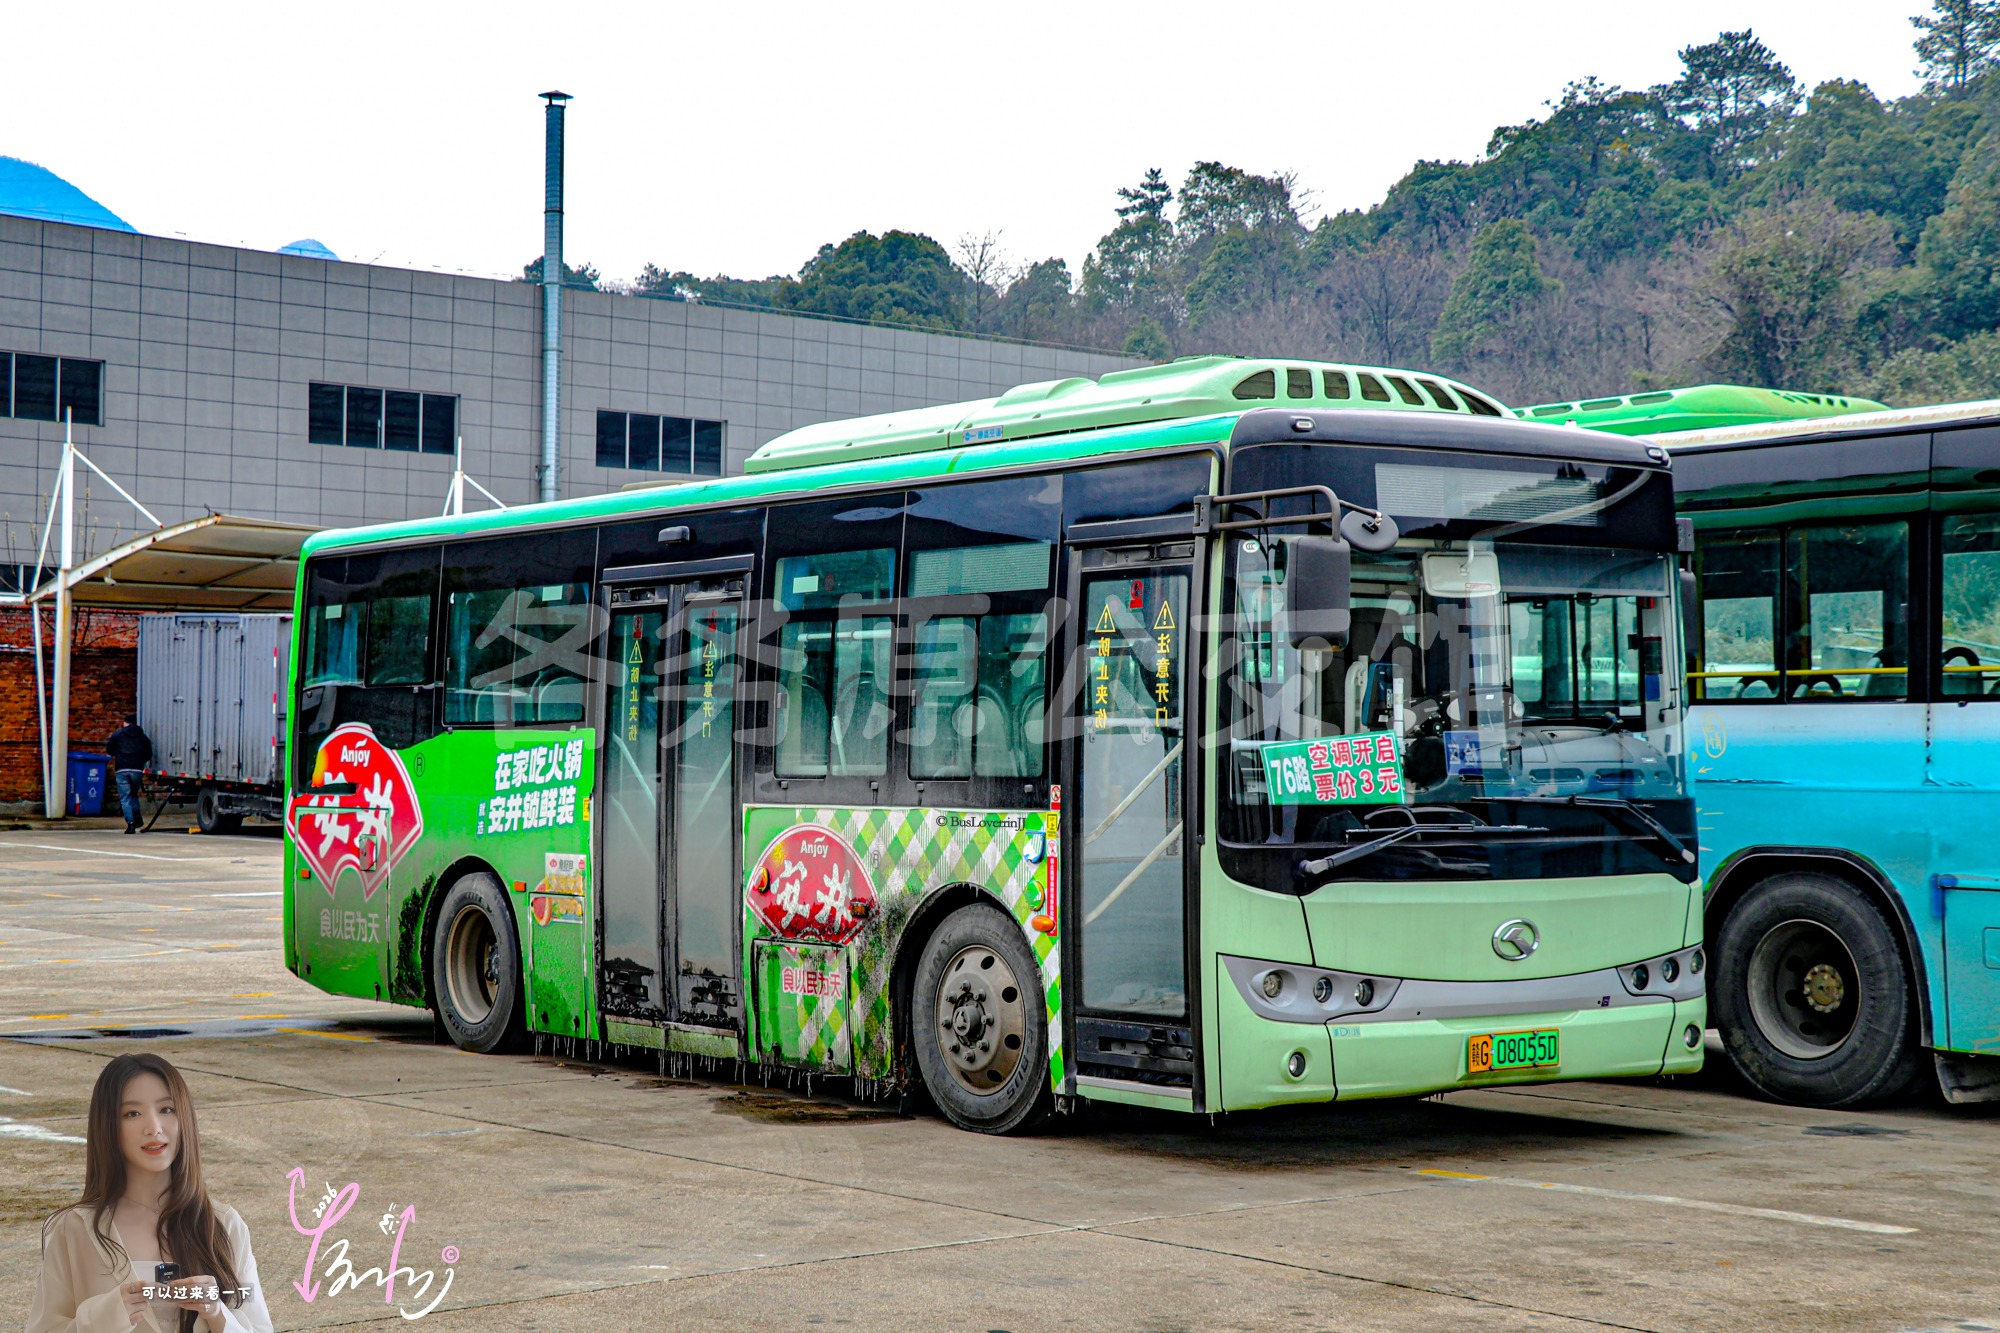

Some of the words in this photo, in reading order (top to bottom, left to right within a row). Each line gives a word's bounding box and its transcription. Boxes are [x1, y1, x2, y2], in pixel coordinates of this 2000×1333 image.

[341, 738, 370, 768] Anjoy
[495, 739, 583, 791] 在家吃火锅
[1307, 735, 1397, 770] 空调开启
[1270, 755, 1312, 795] 76路
[1313, 767, 1400, 801] 票价3元
[488, 785, 577, 833] 安井锁鲜装
[800, 836, 829, 859] Anjoy
[770, 860, 853, 934] 安井
[320, 908, 380, 944] 食以民为天
[782, 966, 843, 999] 食以民为天
